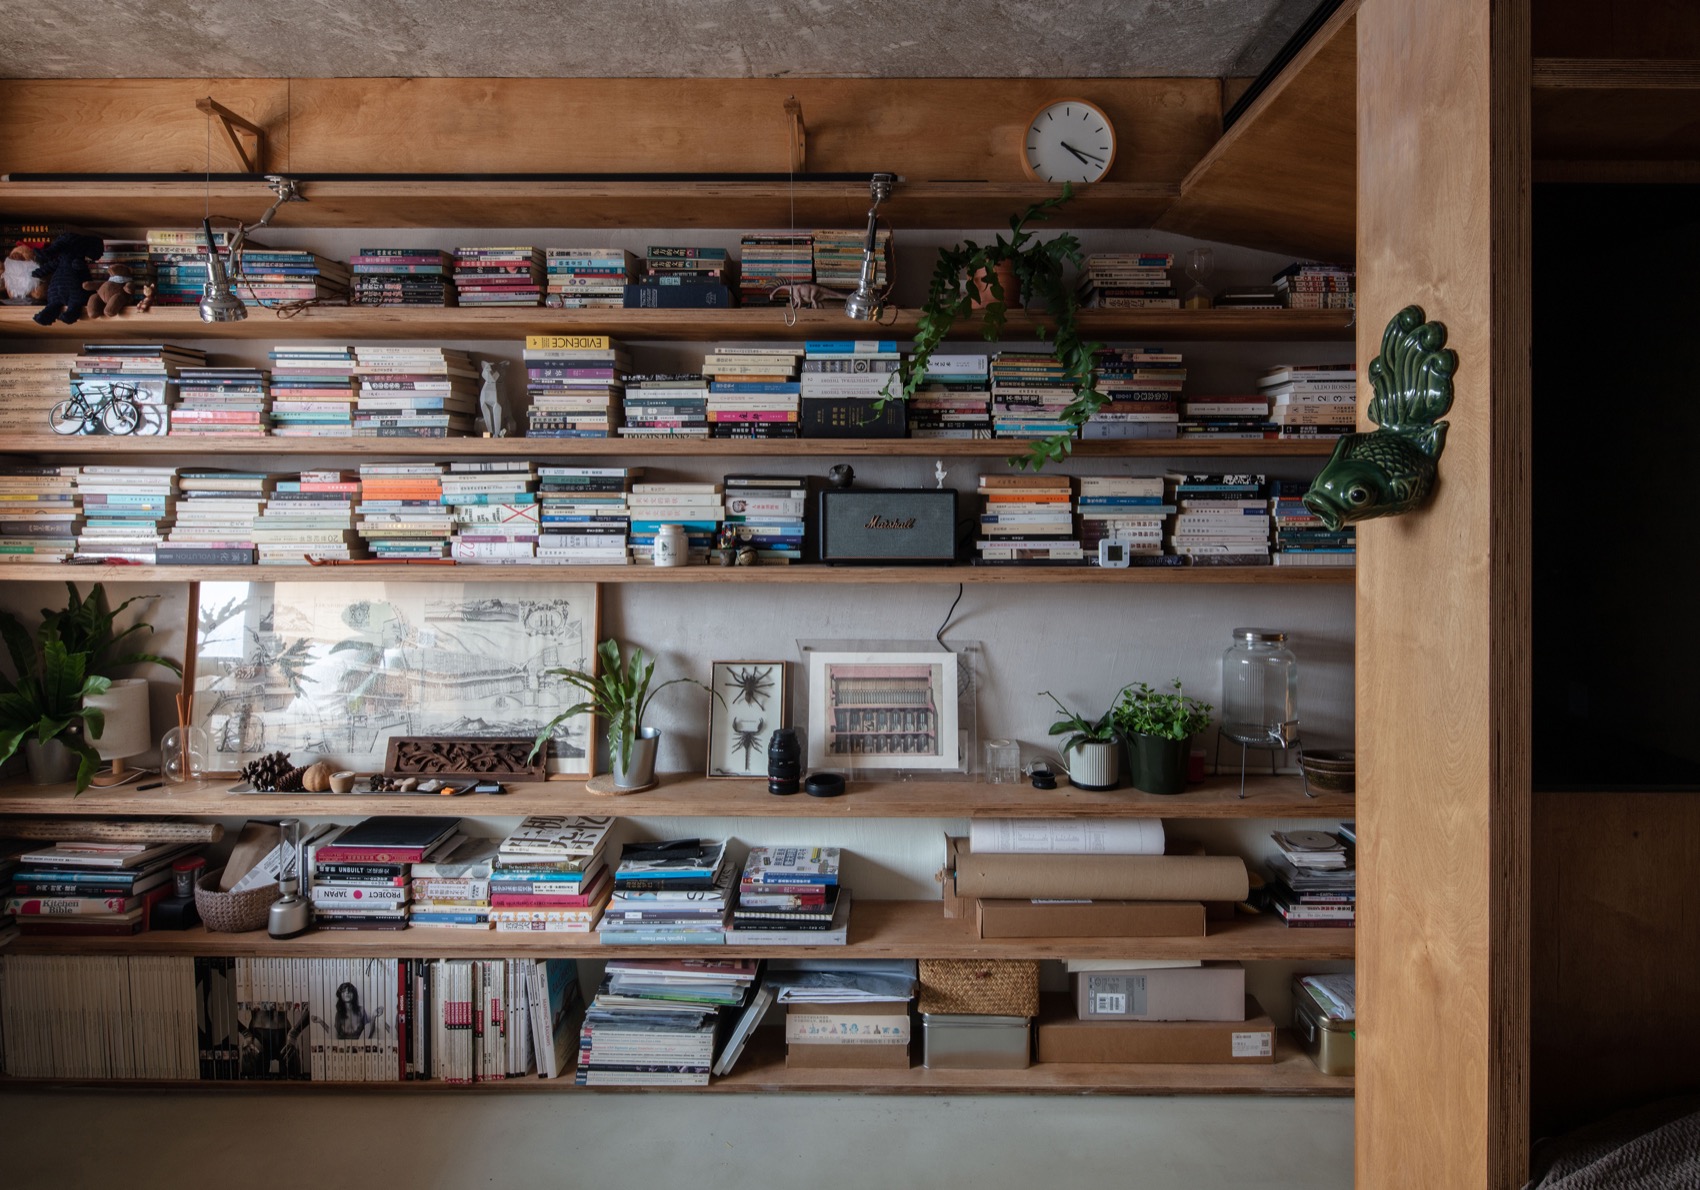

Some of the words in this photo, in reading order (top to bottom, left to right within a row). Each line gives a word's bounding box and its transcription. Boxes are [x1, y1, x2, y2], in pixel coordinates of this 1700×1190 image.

[552, 338, 602, 348] EVIDENCE
[864, 515, 916, 530] Marshall
[324, 890, 347, 898] JAPAN
[42, 899, 79, 908] Kitchen
[49, 906, 73, 914] Bible
